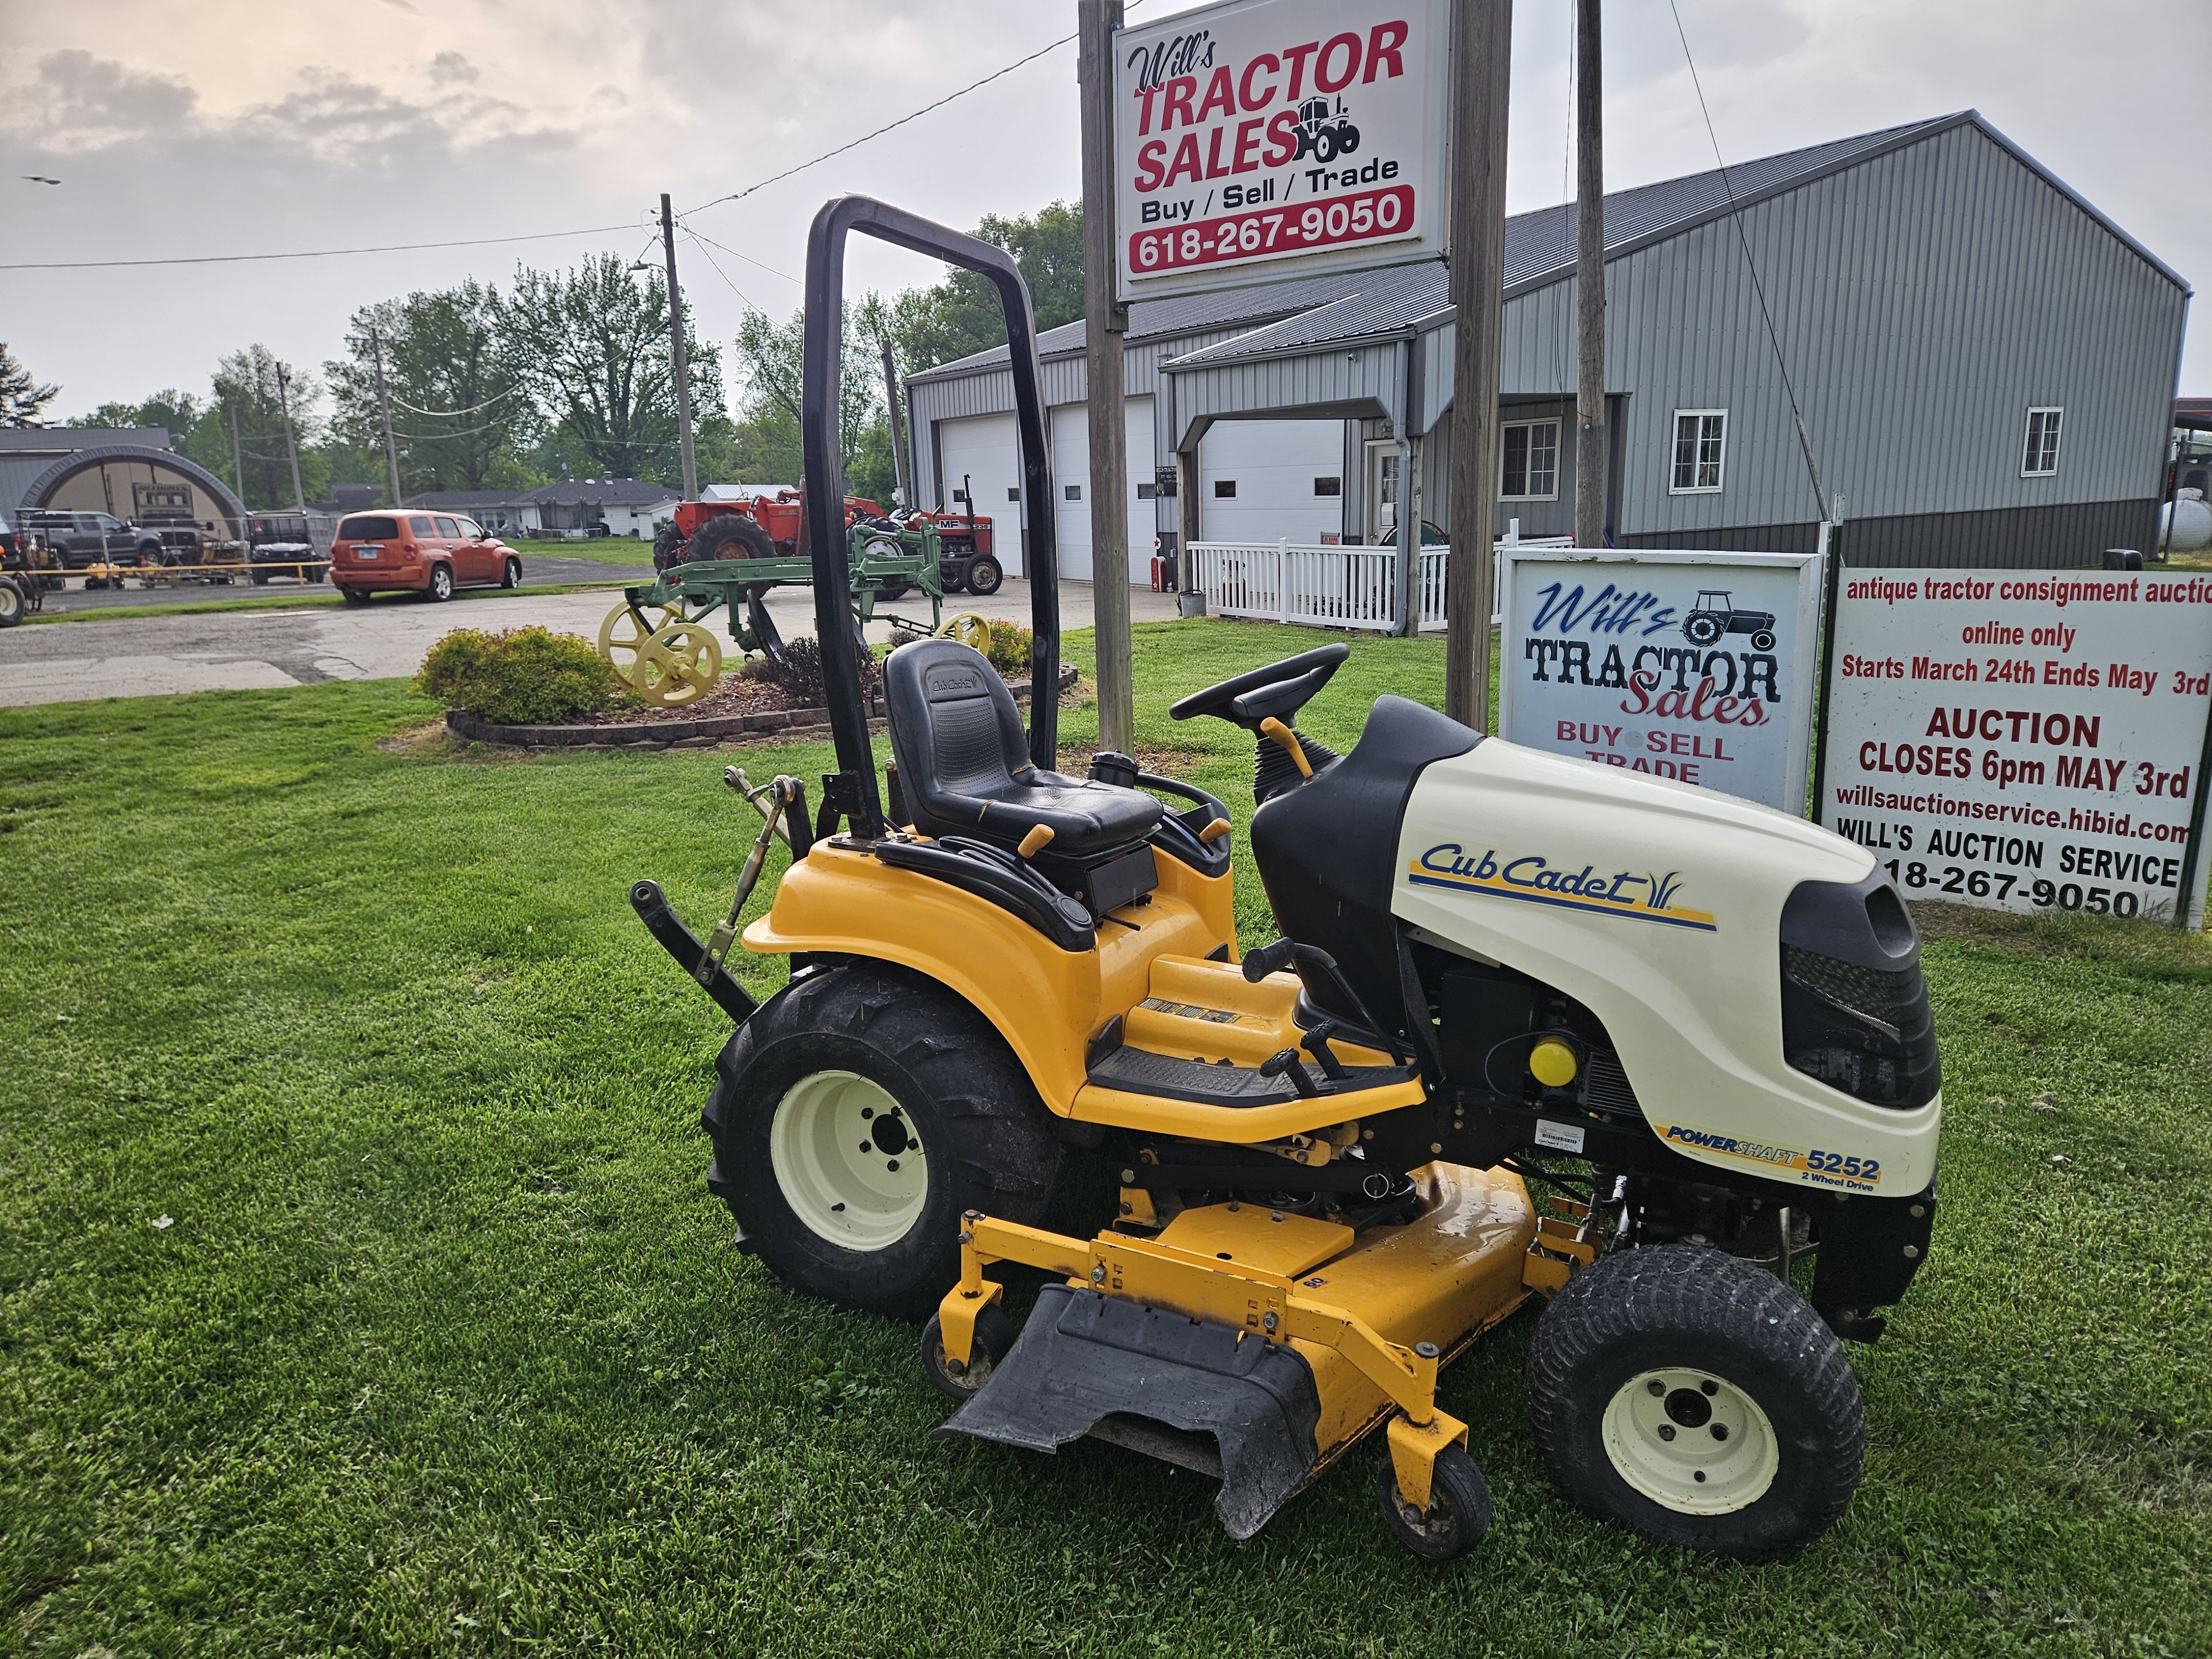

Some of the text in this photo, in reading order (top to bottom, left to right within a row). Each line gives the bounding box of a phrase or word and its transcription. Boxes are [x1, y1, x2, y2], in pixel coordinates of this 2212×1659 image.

[1127, 30, 1217, 93] Will's
[1134, 20, 1408, 137] TRACTOR
[1134, 110, 1300, 193] SALES
[1141, 157, 1399, 224] Buy / Sell / Trade
[1139, 193, 1401, 267] 618-267-9050
[1532, 582, 1679, 637] Will's
[1847, 576, 1918, 605] antique
[1924, 577, 1995, 601] tractor
[2000, 576, 2138, 607] consignment
[1961, 621, 2076, 653] online only
[933, 680, 947, 692] Cub
[1525, 637, 1782, 703] TRACTOR
[1620, 670, 1769, 727] Sales
[1841, 654, 2210, 696] Starts March 24th Ends May 3rd
[1557, 720, 1734, 762] BUY SELL
[1926, 707, 2100, 748] AUCTION
[1860, 742, 2190, 799] CLOSES 6pm MAY 3rd
[1837, 786, 2190, 843] willsauctionservice.hibid.com
[1420, 843, 1648, 905] Cub Cadet
[1838, 817, 2180, 888] WILL'S AUCTION SERVICE
[1877, 859, 2139, 919] 18-267-9050
[1802, 1171, 1874, 1192] 2 Wheel Drive
[1807, 1149, 1880, 1180] 5252
[1303, 1278, 1324, 1287] 60
